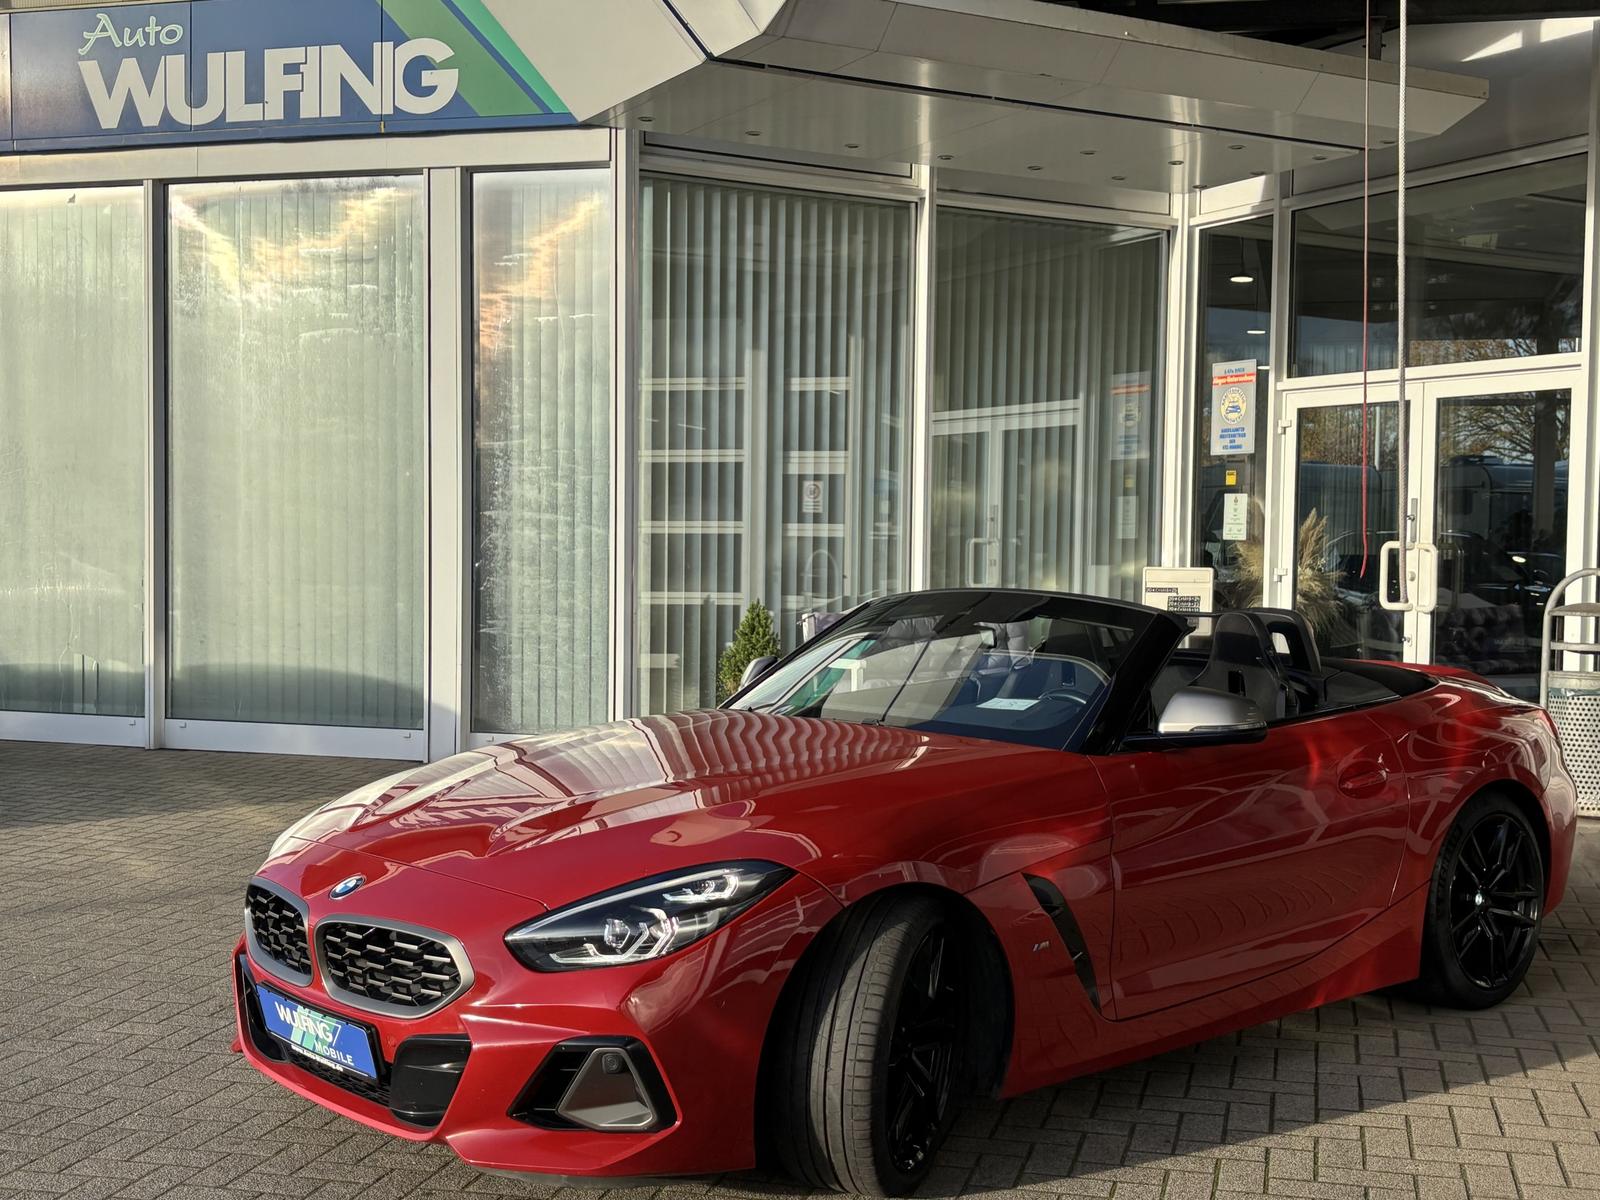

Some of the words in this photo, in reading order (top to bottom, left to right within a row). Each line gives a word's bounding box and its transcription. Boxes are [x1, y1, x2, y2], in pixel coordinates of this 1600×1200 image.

[79, 14, 184, 54] Auto
[78, 38, 459, 129] WULFING
[274, 1001, 334, 1043] WULFING
[314, 1039, 355, 1066] MOBILE
